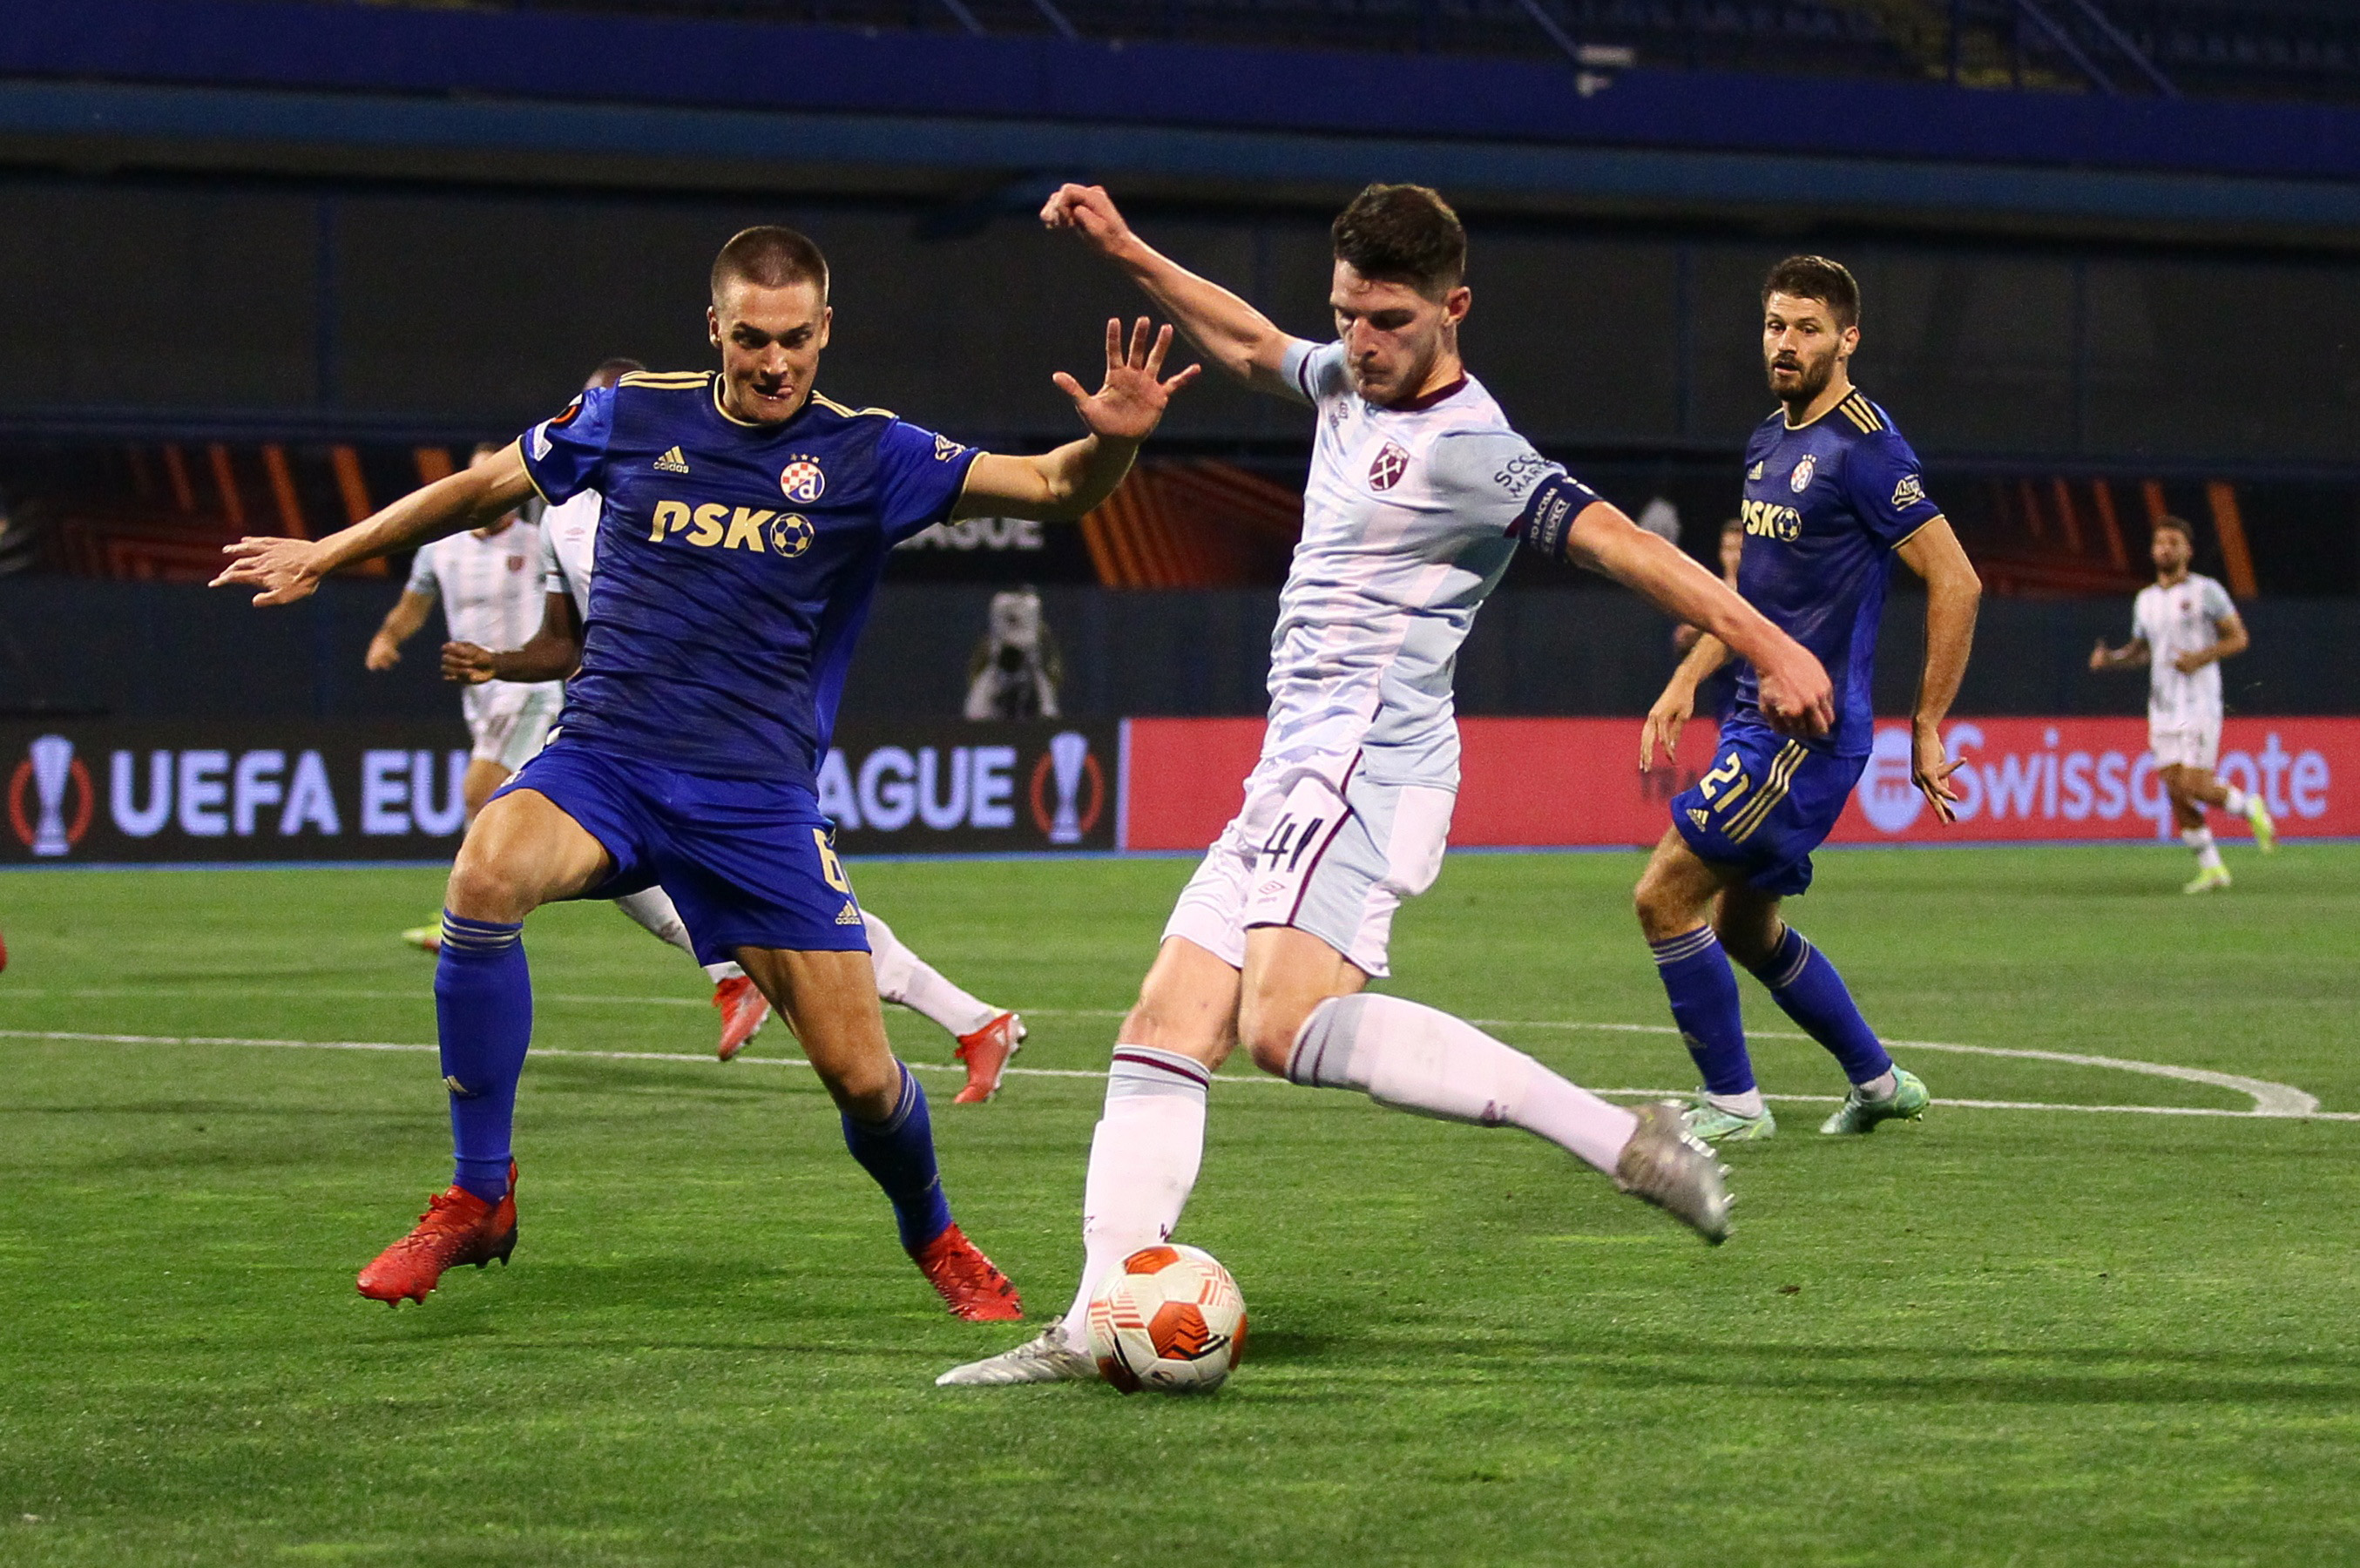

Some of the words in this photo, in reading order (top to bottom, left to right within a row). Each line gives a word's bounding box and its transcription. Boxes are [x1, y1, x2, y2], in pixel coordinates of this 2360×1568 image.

[110, 749, 341, 838] UEFA
[360, 749, 470, 837] EU
[1700, 752, 1749, 813] 21
[1944, 723, 2330, 842] Swissqote
[812, 828, 850, 895] 6
[1261, 813, 1324, 873] 41
